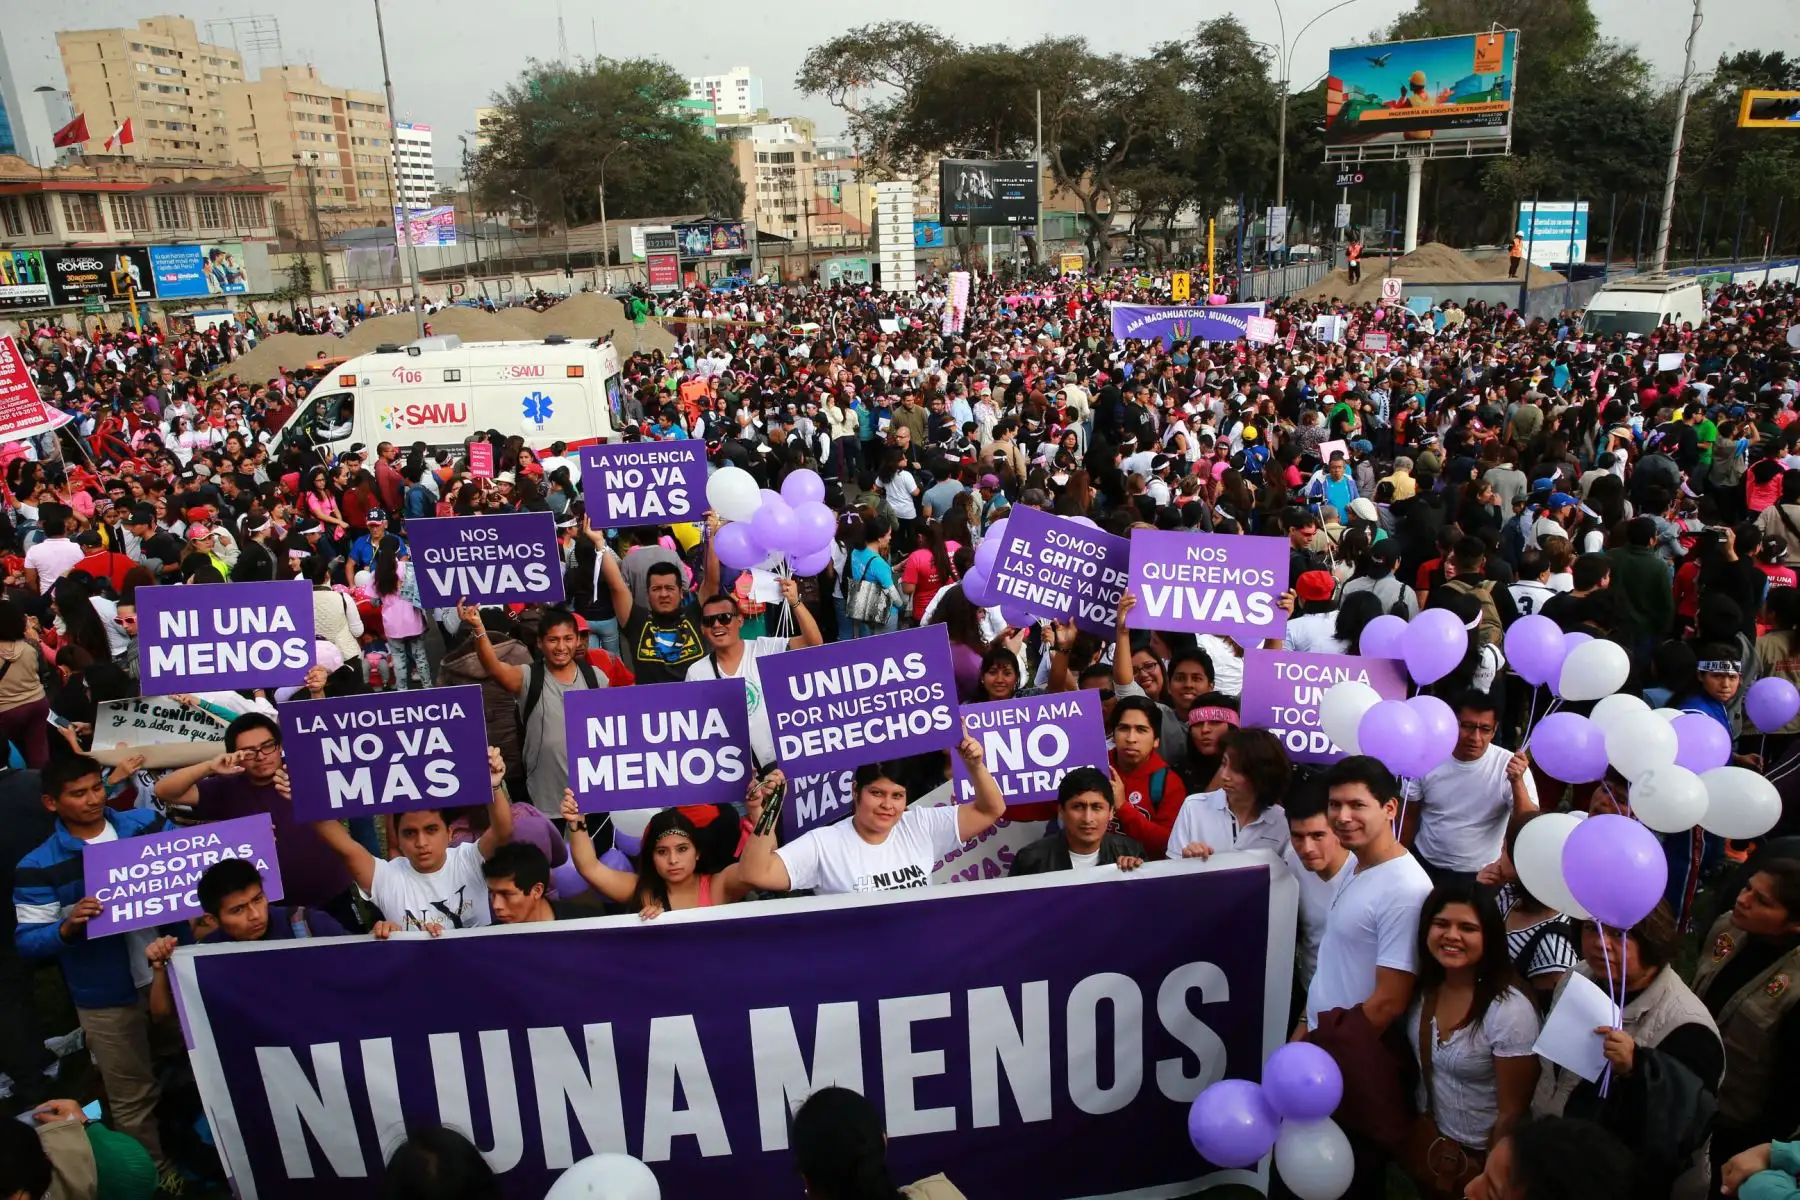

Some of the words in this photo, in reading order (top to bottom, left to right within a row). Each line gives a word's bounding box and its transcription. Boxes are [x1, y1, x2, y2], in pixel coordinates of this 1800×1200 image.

[56, 261, 103, 272] ROMERO
[892, 252, 902, 290] MARI
[1126, 318, 1144, 333] AMA
[1209, 310, 1248, 334] MUNAHUA
[10, 382, 28, 392] DIAZ
[400, 370, 422, 383] 106
[512, 365, 544, 378] SAMU
[17, 415, 44, 427] JUSTICIA
[406, 402, 466, 425] SAMU
[590, 456, 610, 468] LA
[614, 451, 695, 466] VIOLENCIA
[605, 469, 643, 490] NO
[651, 466, 686, 486] VA
[607, 483, 691, 519] MÁS
[460, 528, 498, 542] NOS
[1045, 529, 1107, 560] SOMOS
[424, 543, 545, 563] QUEREMOS
[1010, 538, 1032, 558] EL
[1040, 548, 1097, 577] GRITO
[1102, 568, 1128, 589] DE
[1186, 547, 1227, 562] NOS
[426, 562, 551, 597] VIVAS
[1003, 557, 1035, 576] LAS
[1038, 568, 1073, 589] QUE
[1077, 579, 1093, 597] YA
[1098, 586, 1122, 605] NO
[1143, 563, 1274, 587] QUEREMOS
[996, 572, 1072, 613] TIENEN
[1078, 599, 1117, 627] VOZ
[1141, 583, 1274, 625] VIVAS
[159, 610, 199, 639] NI
[213, 605, 296, 635] UNA
[149, 638, 309, 678] MENOS
[788, 652, 927, 701] UNIDAS
[1274, 663, 1350, 683] TOCAN
[1357, 669, 1371, 686] A
[776, 706, 823, 730] POR
[828, 683, 945, 720] NUESTROS
[1294, 685, 1328, 706] UN
[132, 718, 147, 728] es
[148, 720, 174, 732] dolor
[178, 724, 190, 735] lo
[191, 729, 207, 742] que
[296, 715, 328, 734] LA
[334, 702, 466, 730] VIOLENCIA
[586, 715, 627, 748] NI
[642, 708, 730, 744] UNA
[965, 707, 1030, 730] QUIEN
[1037, 701, 1083, 721] AMA
[1271, 706, 1322, 726] TOC
[321, 733, 383, 765] NO
[396, 727, 453, 756] VA
[778, 705, 952, 761] DERECHOS
[983, 724, 1069, 773] NO
[1268, 728, 1343, 755] TOD
[325, 752, 460, 809] MÁS
[577, 746, 745, 793] MENOS
[961, 765, 1096, 800] MLTRA
[796, 771, 854, 828] MÁS
[140, 833, 222, 858] AHORA
[109, 844, 254, 884] NOSOTRAS
[892, 865, 925, 883] UNA
[95, 871, 202, 902] CAMBIAM
[111, 889, 200, 922] HISTO
[254, 1037, 409, 1178] NI
[428, 1014, 734, 1174] UNA
[749, 961, 1230, 1152] MENOS
